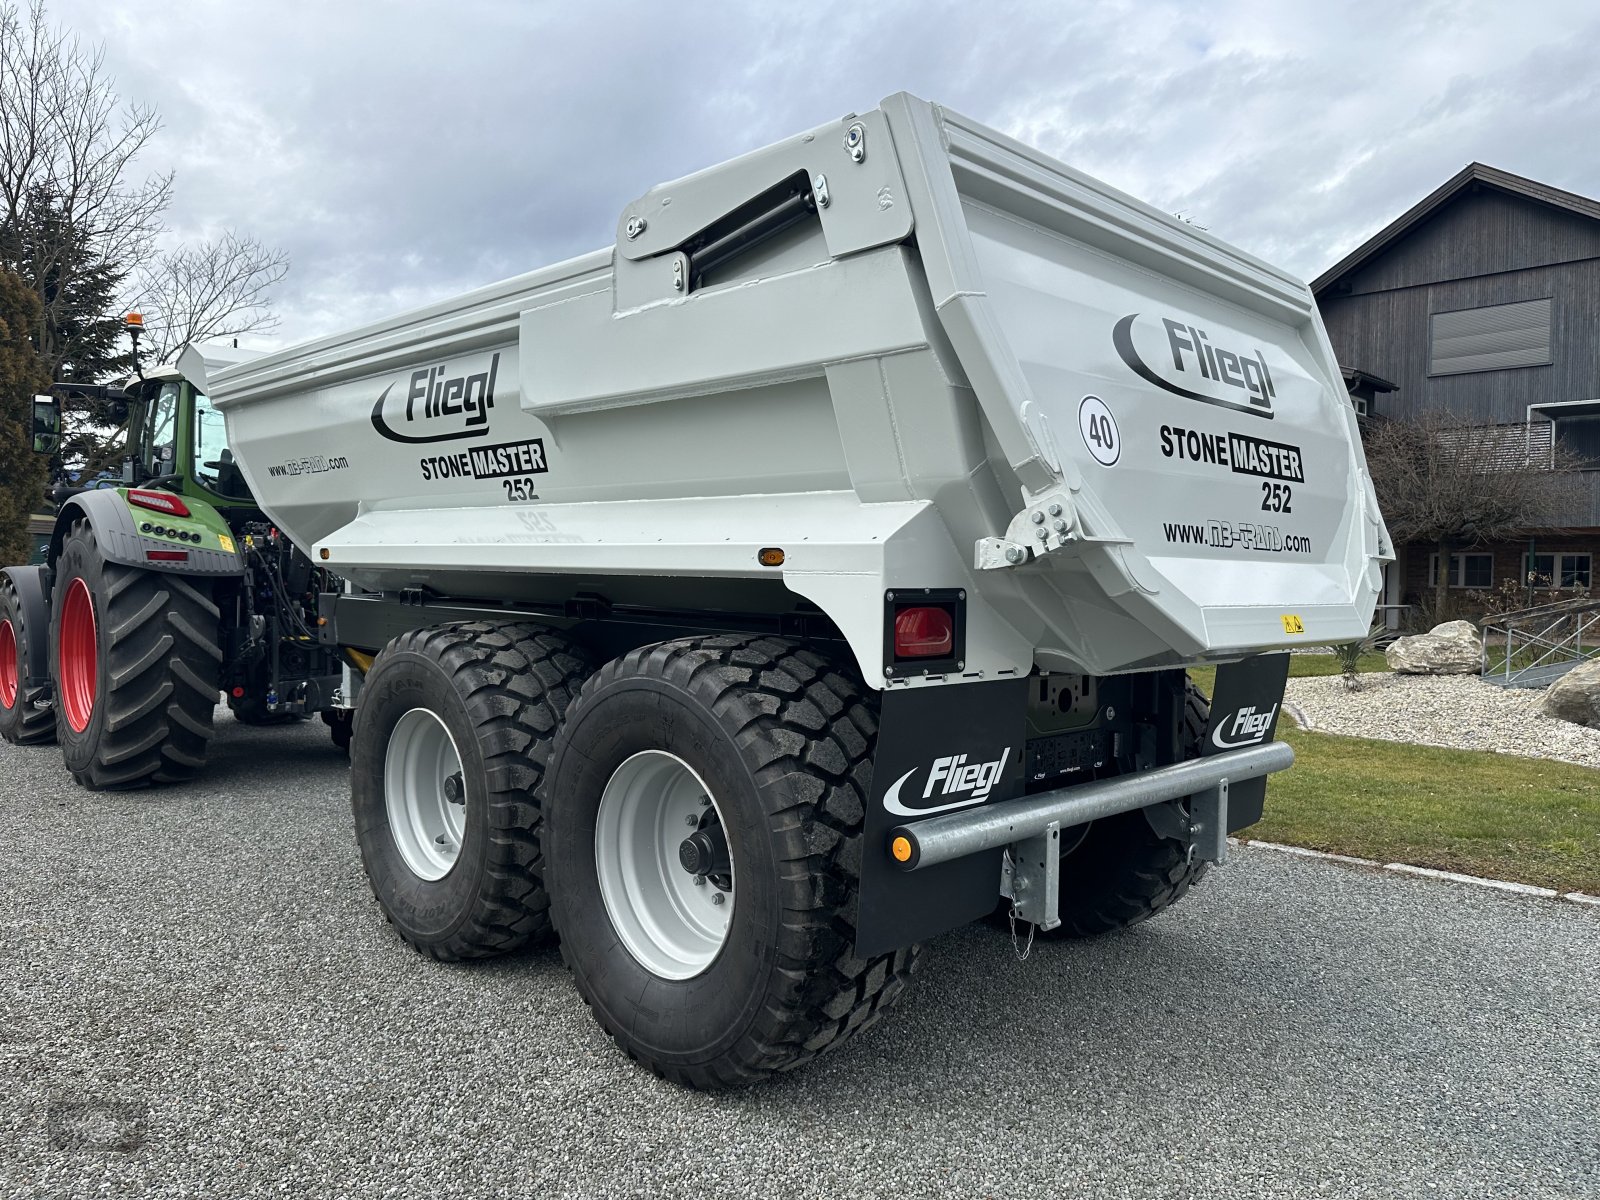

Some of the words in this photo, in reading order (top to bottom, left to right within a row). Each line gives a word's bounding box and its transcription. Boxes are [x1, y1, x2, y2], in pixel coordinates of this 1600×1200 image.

[1162, 318, 1276, 408] Fliegl
[406, 353, 500, 426] Fliegl
[1090, 413, 1113, 450] 40
[503, 478, 539, 501] 252
[1261, 482, 1292, 513] 252
[1230, 703, 1277, 738] Fliegl
[922, 747, 1011, 798] Fliegl
